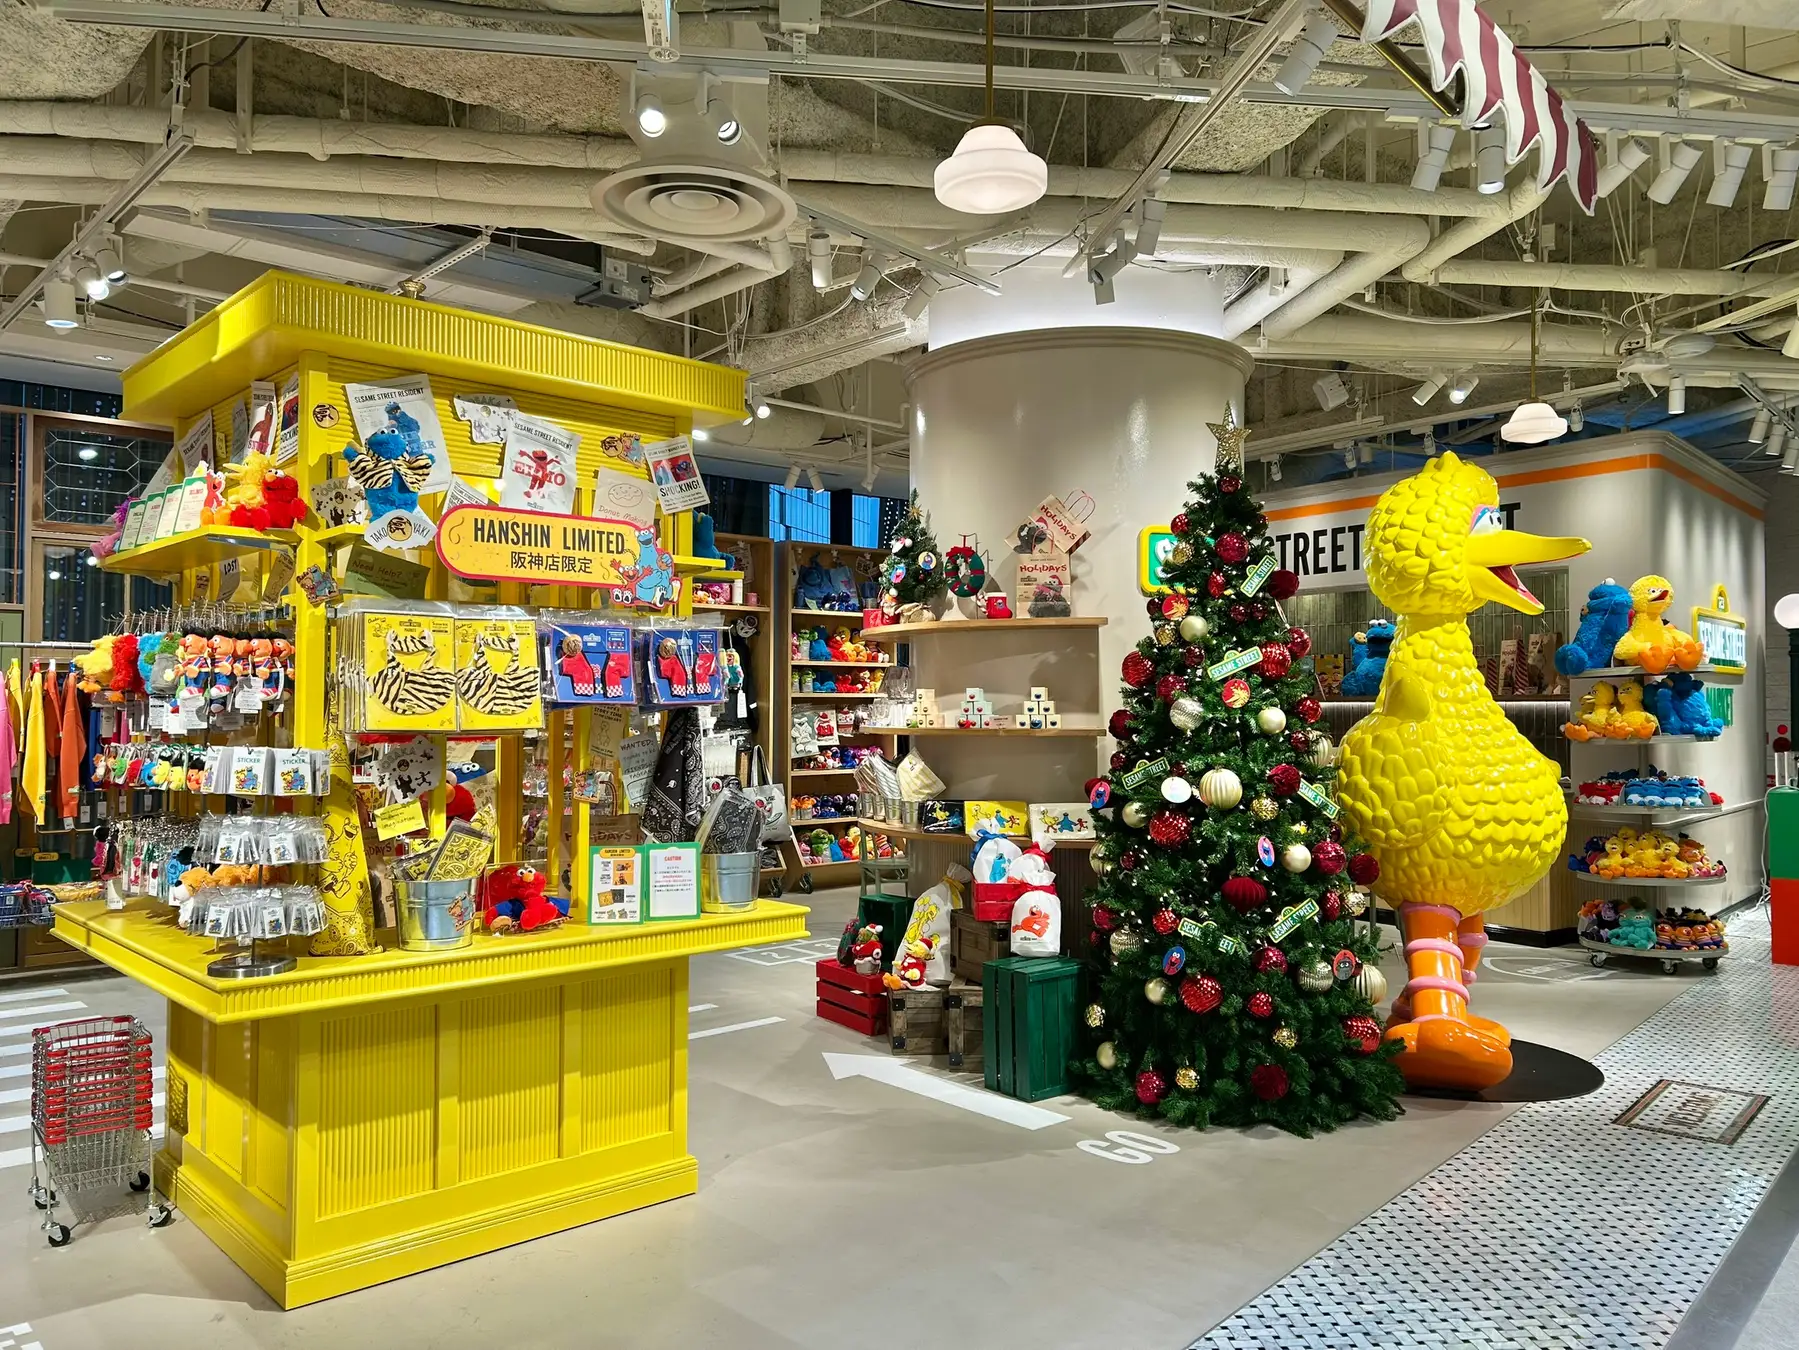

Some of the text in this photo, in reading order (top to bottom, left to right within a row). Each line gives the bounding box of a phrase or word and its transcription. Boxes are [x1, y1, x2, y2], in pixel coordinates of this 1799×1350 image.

[354, 387, 425, 403] SESAME STREET RESIDENT
[514, 422, 534, 435] SESAME
[534, 429, 552, 442] STREET
[660, 480, 701, 498] SHOCKING!
[370, 522, 431, 543] TAKO YAKI
[1040, 504, 1078, 541] HOLIDAYS
[474, 518, 625, 555] HANSHIN LIMITED
[224, 558, 237, 576] LOST
[352, 561, 403, 579] Need Help?
[510, 551, 593, 574] 阪神店限定
[1020, 564, 1068, 573] HOLIDAYS
[1212, 651, 1259, 678] SESAME STREET
[620, 739, 654, 751] WANTED:
[1272, 902, 1316, 939] SESAME STREET
[1076, 1131, 1181, 1164] GO
